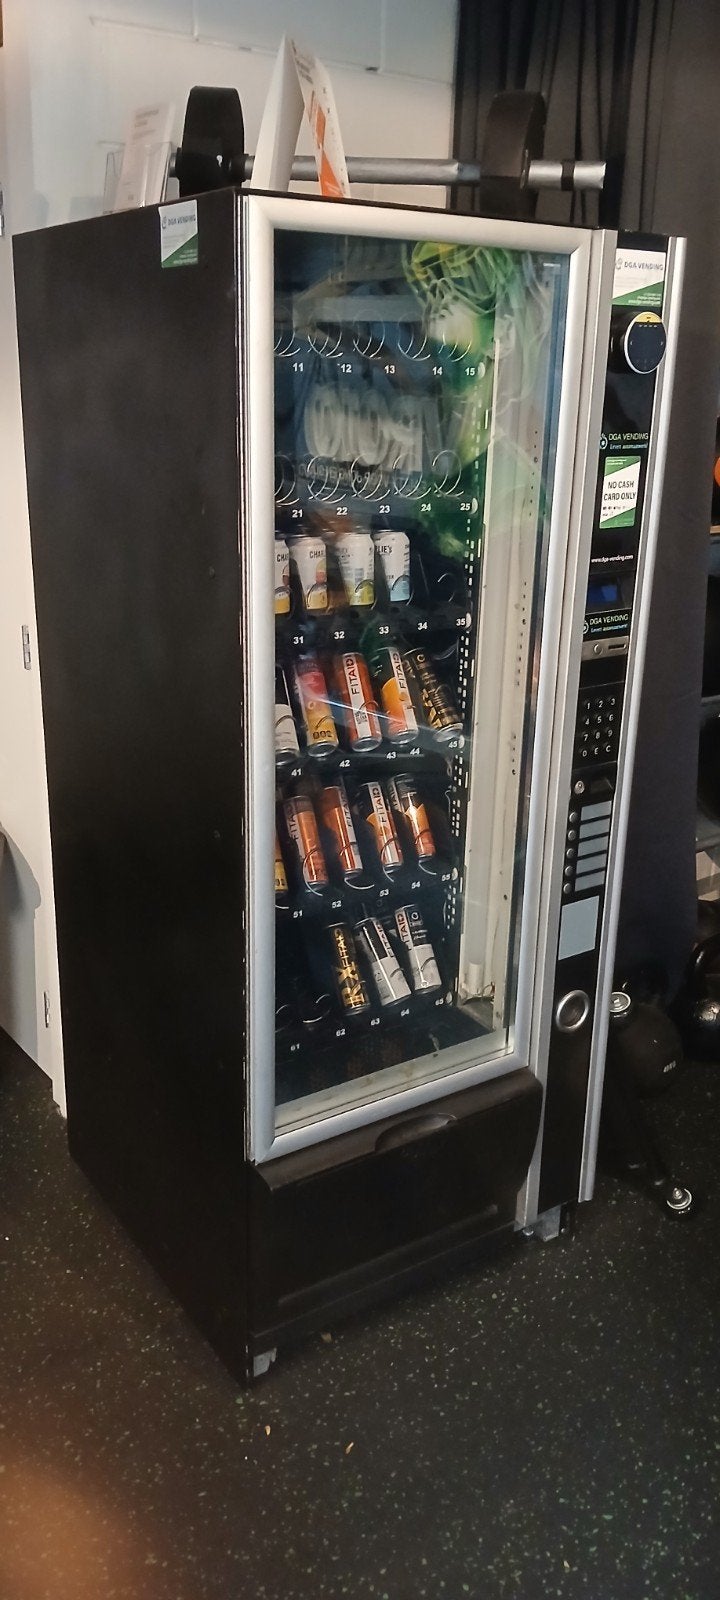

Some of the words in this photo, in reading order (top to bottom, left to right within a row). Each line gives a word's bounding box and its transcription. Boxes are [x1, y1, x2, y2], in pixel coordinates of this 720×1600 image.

[637, 262, 663, 270] VENDING
[292, 362, 304, 372] 11
[340, 364, 352, 374] 12
[384, 366, 396, 374] 13
[432, 366, 442, 376] 14
[466, 368, 476, 376] 15
[604, 492, 620, 500] CARD
[620, 492, 636, 500] ONLY
[336, 506, 348, 516] 22
[380, 506, 390, 514] 23
[420, 504, 432, 512] 24
[460, 502, 472, 512] 25
[292, 510, 302, 518] 21
[456, 616, 468, 626] 35
[603, 614, 628, 624] VENDING
[378, 626, 390, 634] 33
[418, 622, 428, 630] 34
[334, 630, 344, 640] 32
[294, 636, 304, 644] 31
[392, 652, 406, 689] FITAID
[344, 655, 360, 695] FITAID
[598, 716, 602, 724] 5
[448, 740, 460, 748] 45
[386, 752, 396, 760] 43
[410, 748, 420, 756] 44
[340, 760, 350, 768] 42
[292, 768, 302, 776] 41
[372, 786, 388, 825] FITAID
[442, 872, 452, 882] 55
[412, 882, 420, 890] 54
[380, 888, 388, 896] 53
[332, 900, 342, 908] 52
[294, 910, 302, 918] 51
[436, 998, 446, 1006] 65
[400, 1008, 410, 1016] 64
[370, 1018, 380, 1026] 63
[336, 1028, 346, 1036] 62
